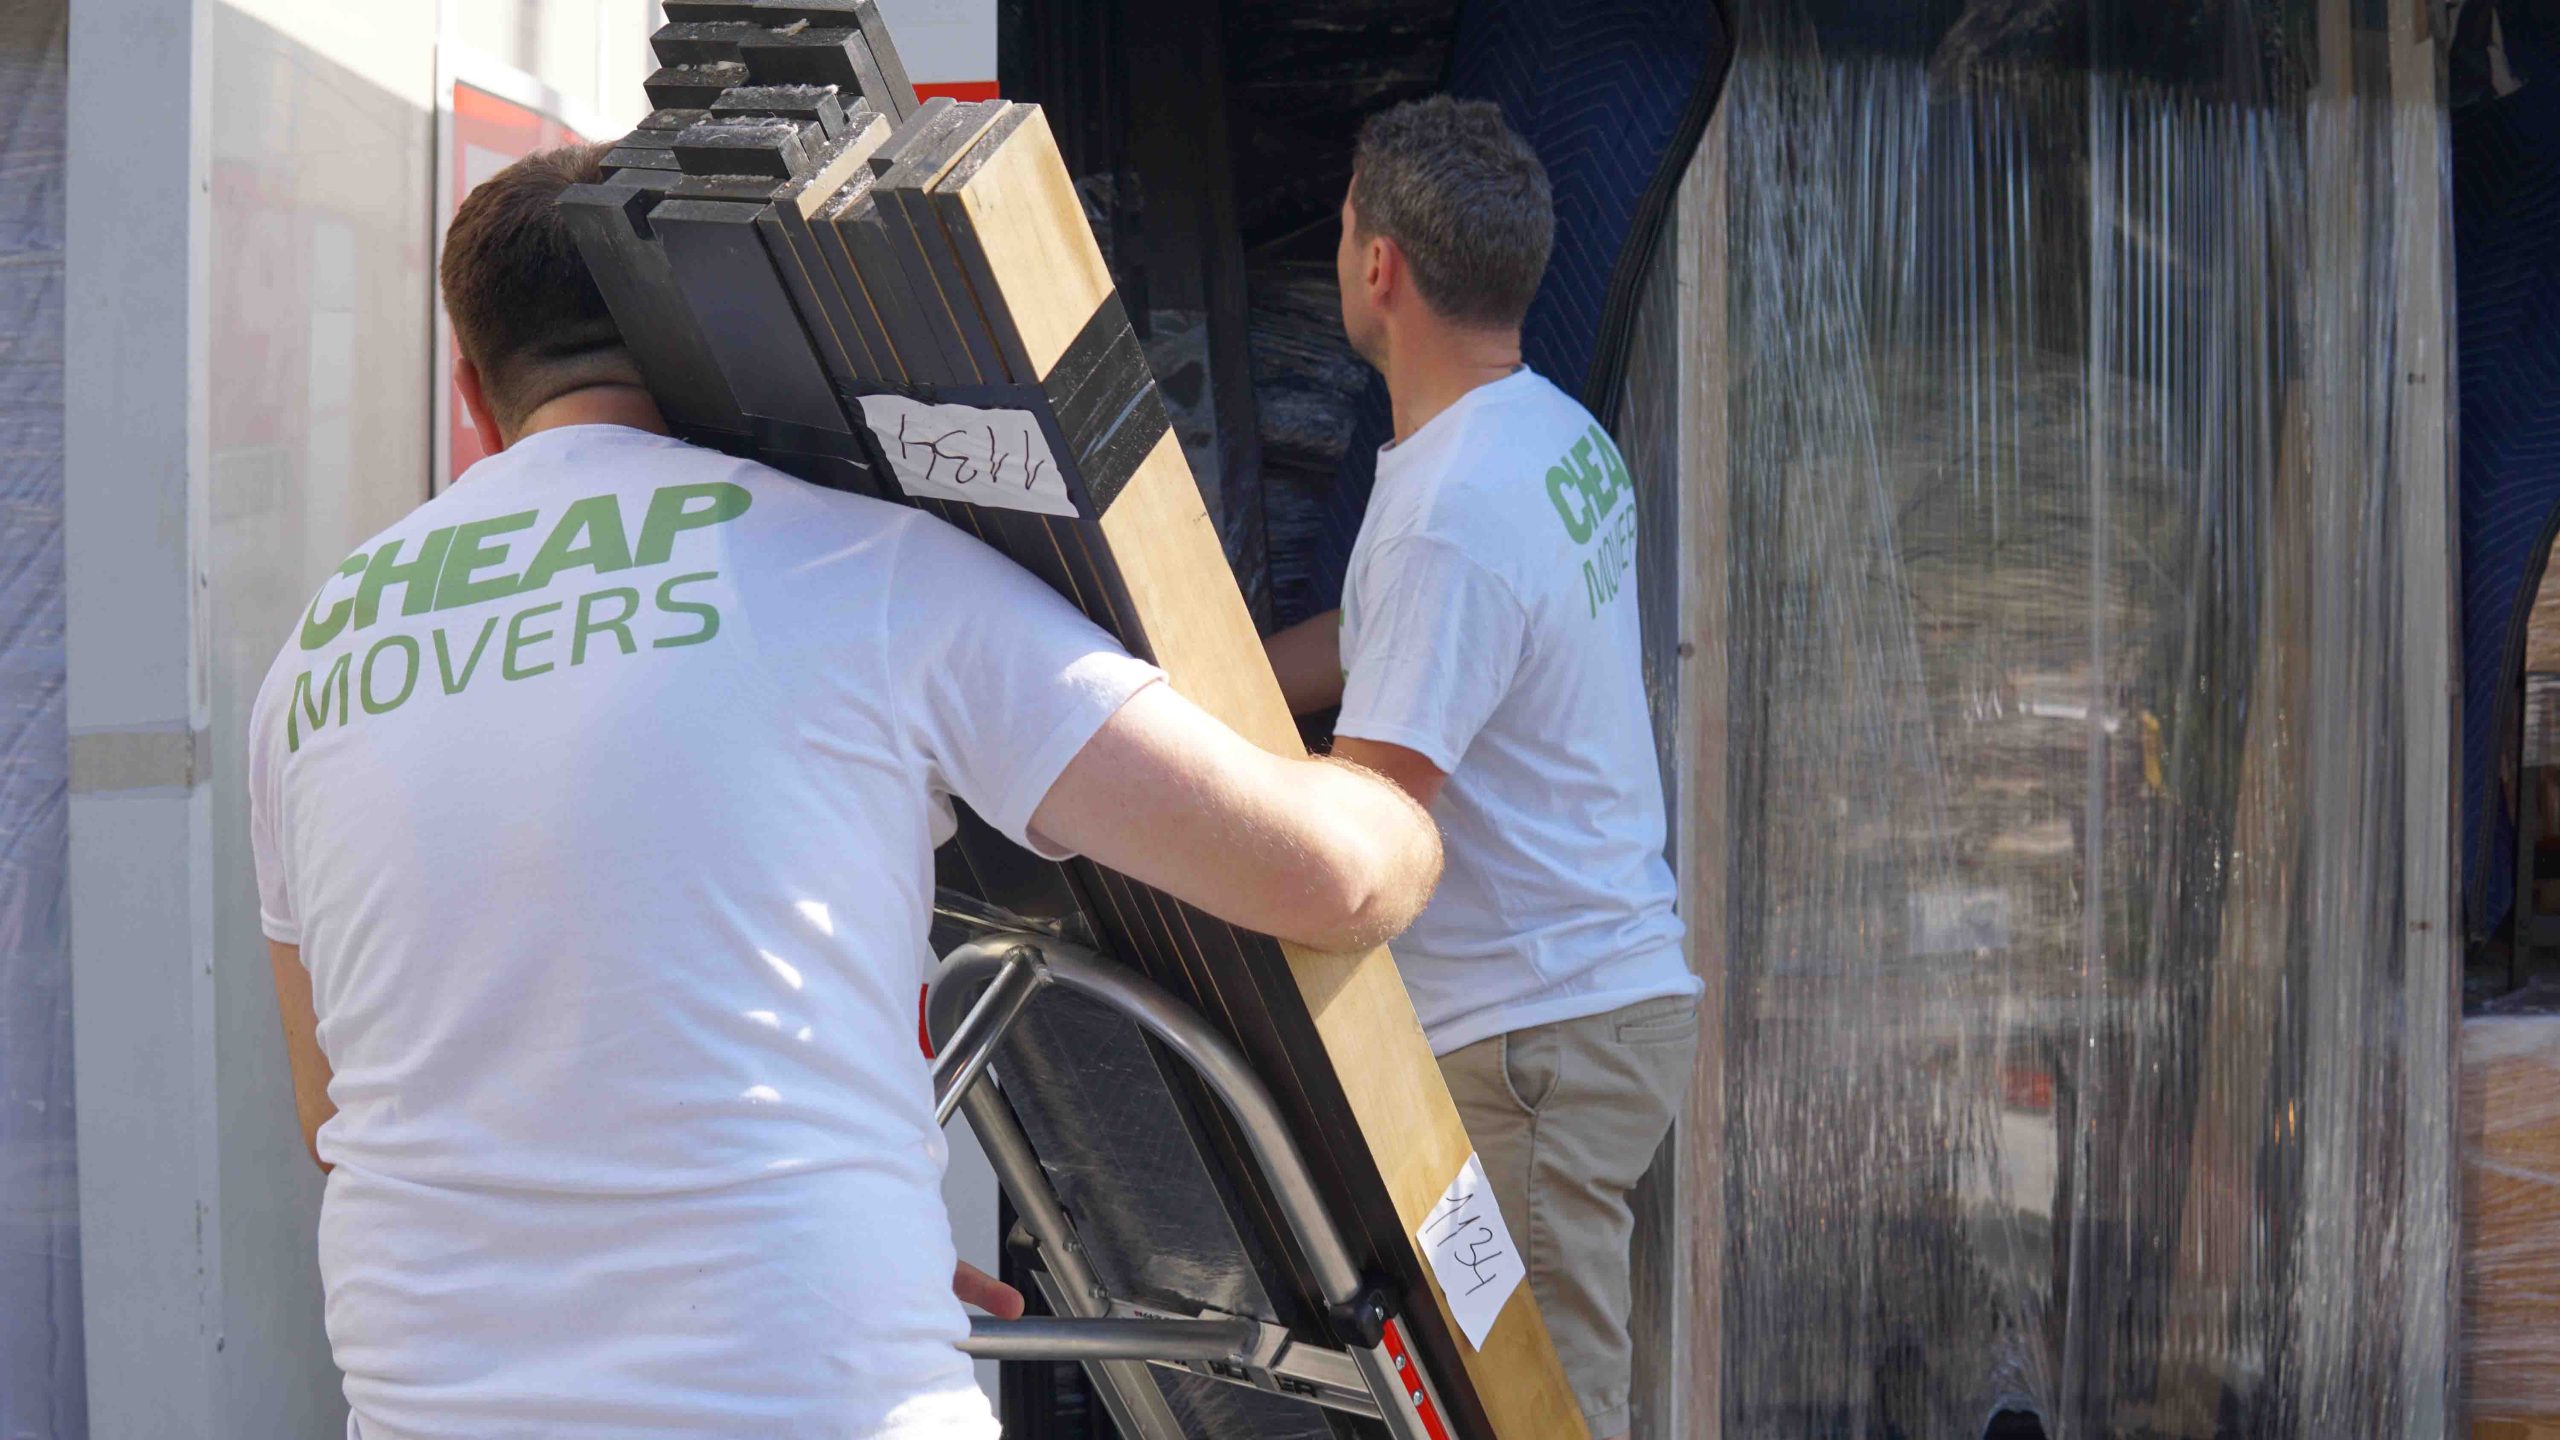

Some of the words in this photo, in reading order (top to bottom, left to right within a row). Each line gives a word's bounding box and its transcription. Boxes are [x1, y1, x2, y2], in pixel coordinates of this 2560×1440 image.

[300, 482, 752, 650] CHEAP
[287, 571, 720, 752] MOVERS
[1425, 1193, 1502, 1296] 1134
